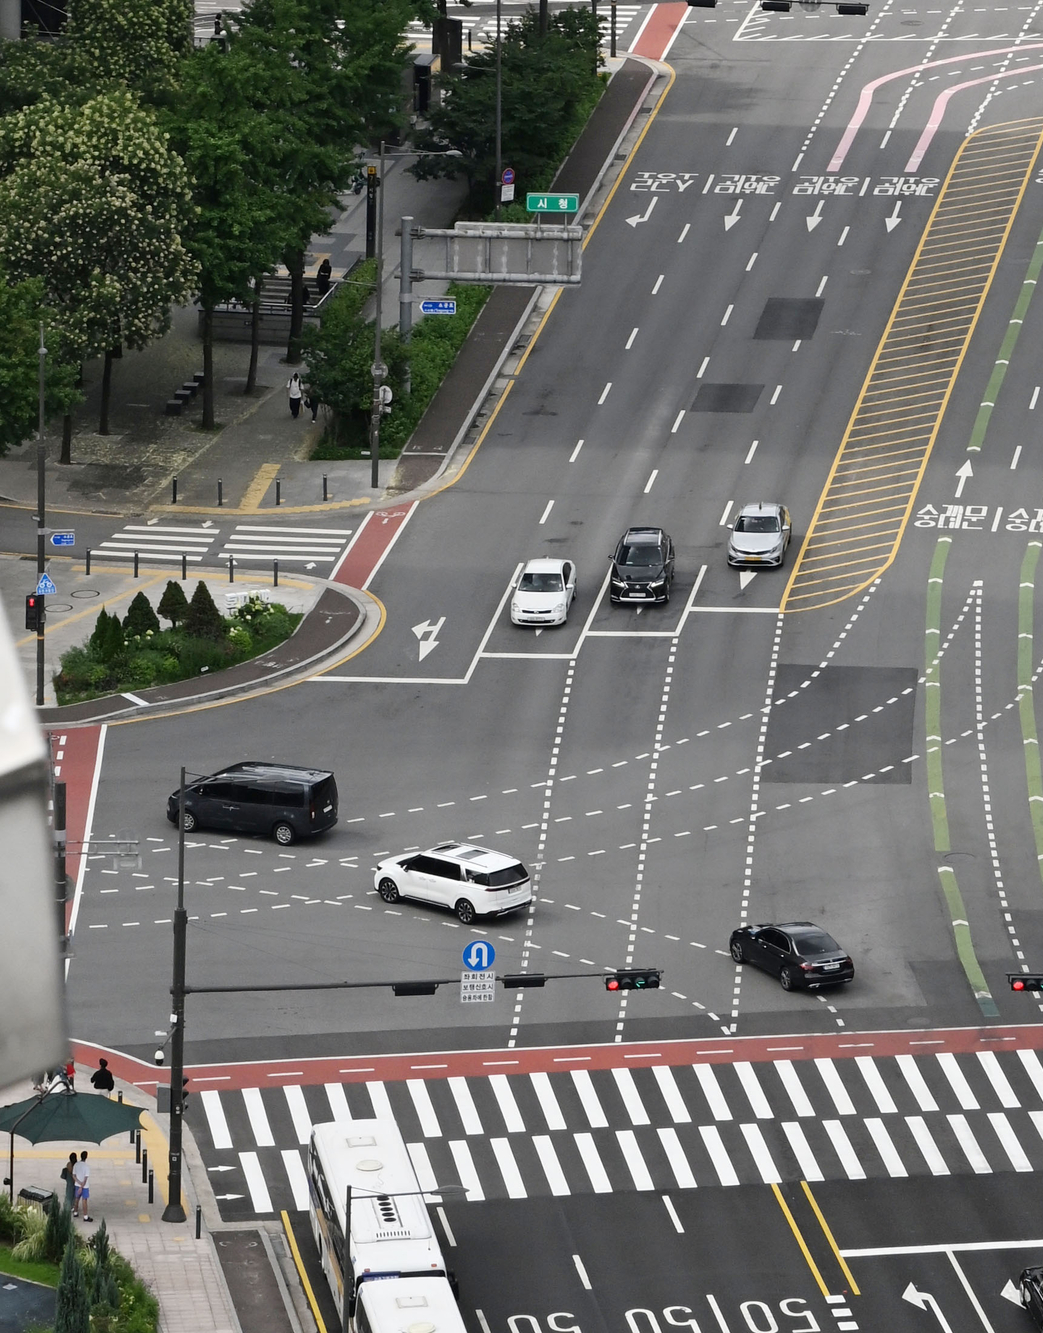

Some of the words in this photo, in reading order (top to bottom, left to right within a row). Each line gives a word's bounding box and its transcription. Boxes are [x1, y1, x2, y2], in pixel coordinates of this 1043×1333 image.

[630, 171, 699, 193] 소공로
[714, 173, 781, 197] 광화문
[794, 174, 860, 197] 광화문
[873, 175, 940, 198] 광화문
[537, 197, 569, 210] 시청
[914, 503, 988, 531] 숭례문
[462, 983, 494, 991] 보행신호시
[463, 973, 494, 981] 좌회전시
[625, 1305, 700, 1333] 50
[738, 1297, 818, 1333] 50
